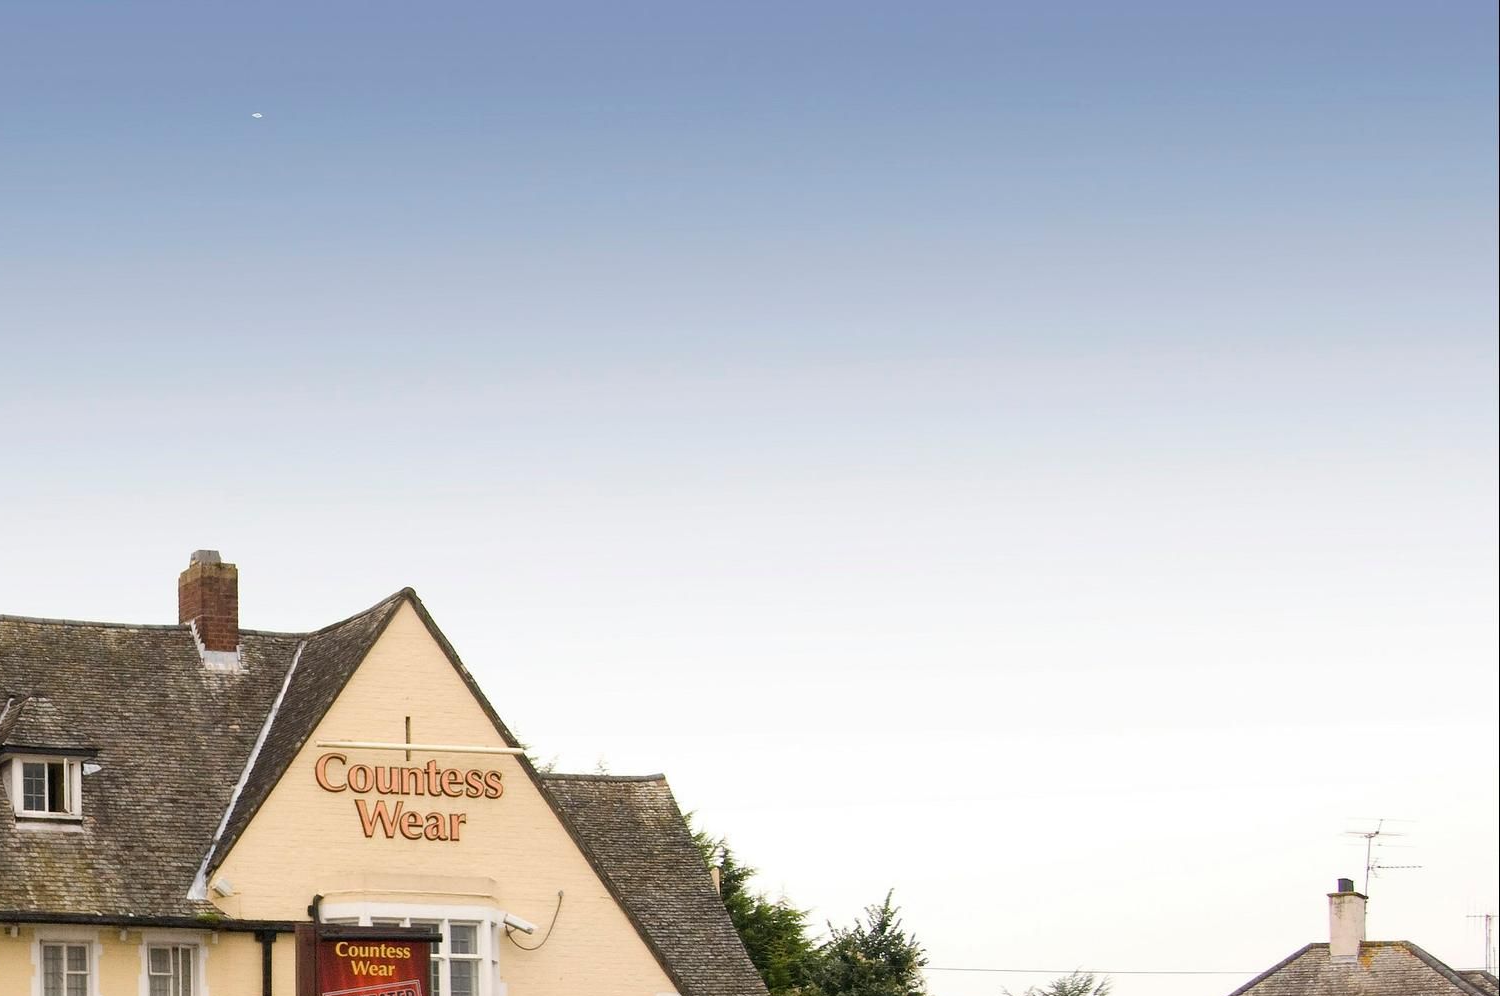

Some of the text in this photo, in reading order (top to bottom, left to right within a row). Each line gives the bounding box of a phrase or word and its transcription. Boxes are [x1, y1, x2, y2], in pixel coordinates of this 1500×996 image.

[315, 752, 504, 799] Countess
[354, 799, 467, 842] Wear
[335, 941, 411, 959] Countess
[350, 960, 396, 976] Wear
